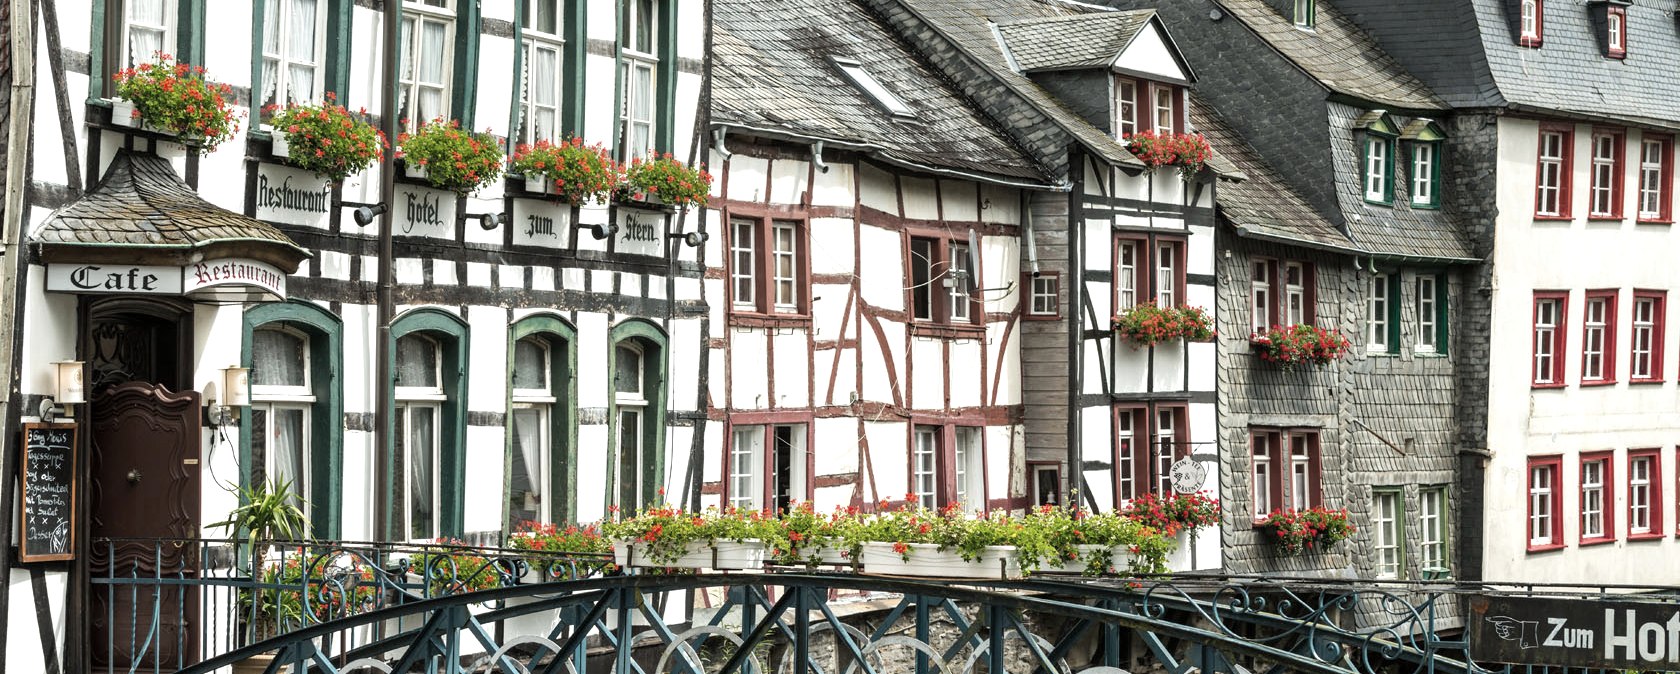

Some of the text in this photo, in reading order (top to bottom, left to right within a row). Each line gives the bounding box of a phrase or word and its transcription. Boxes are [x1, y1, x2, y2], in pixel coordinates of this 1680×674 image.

[258, 174, 660, 246] Restaurant Hotel zum Stern
[70, 265, 158, 291] Cafe
[194, 262, 282, 292] Restaurant
[1172, 460, 1187, 472] WEIN
[1542, 617, 1594, 649] Zum
